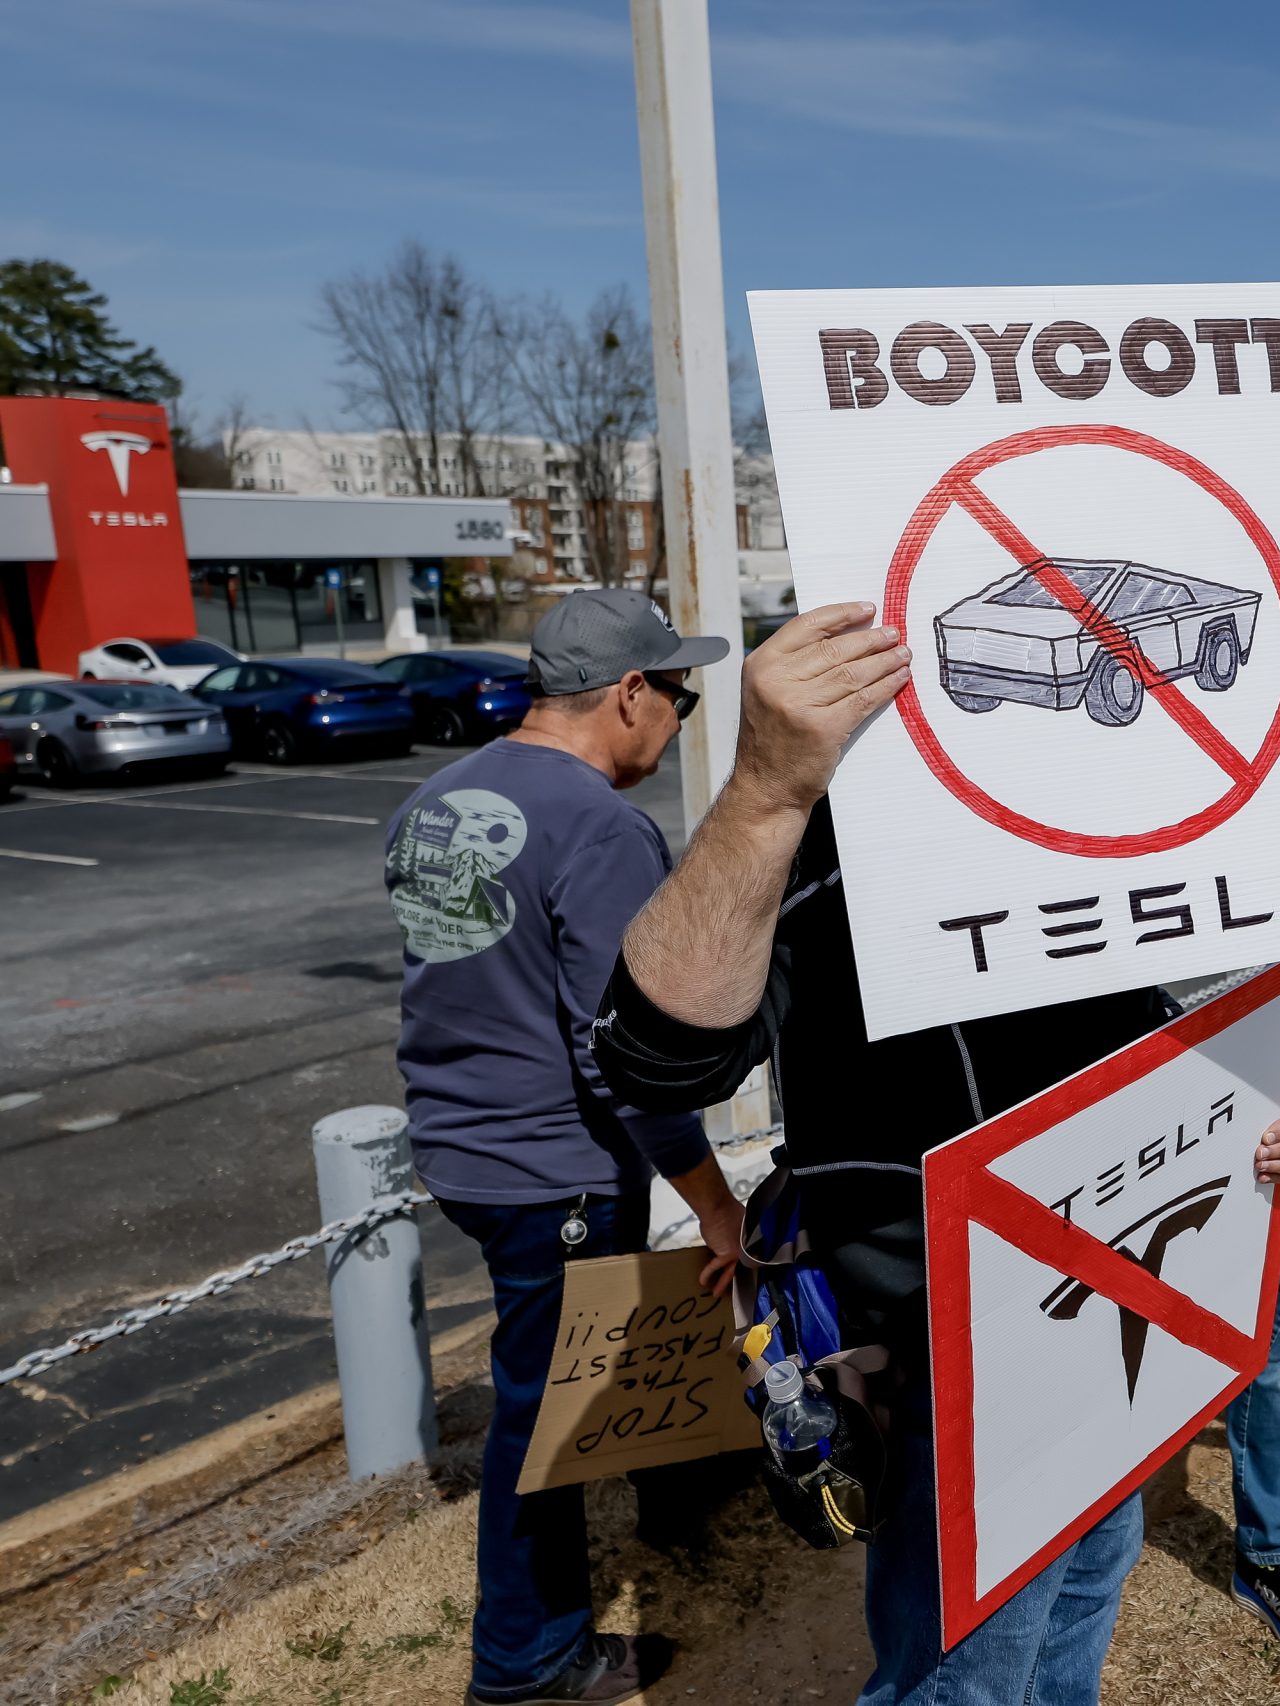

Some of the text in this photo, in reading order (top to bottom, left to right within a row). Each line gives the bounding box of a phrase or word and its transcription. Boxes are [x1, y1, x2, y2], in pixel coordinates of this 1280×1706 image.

[88, 511, 168, 527] TESLA
[1050, 1091, 1236, 1228] TESLA
[551, 1326, 725, 1385] FASCIST
[576, 1378, 713, 1453] STOP
